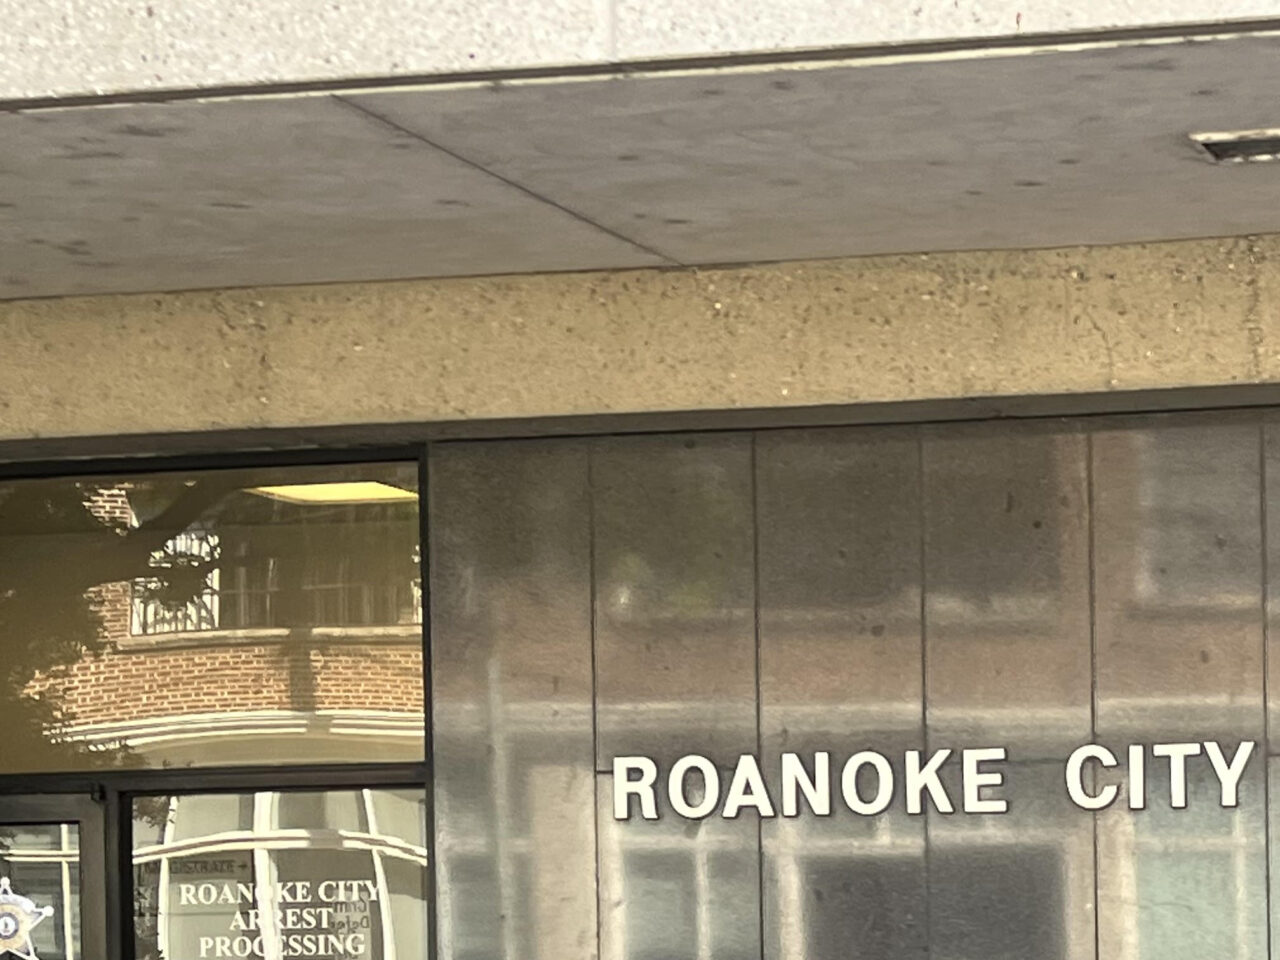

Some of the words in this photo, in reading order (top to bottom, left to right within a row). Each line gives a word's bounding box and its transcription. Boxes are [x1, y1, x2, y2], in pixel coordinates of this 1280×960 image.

[611, 747, 1009, 820] ROANOKE
[1065, 740, 1256, 811] CITY
[179, 881, 313, 905] ROANKE
[317, 880, 380, 902] CITY
